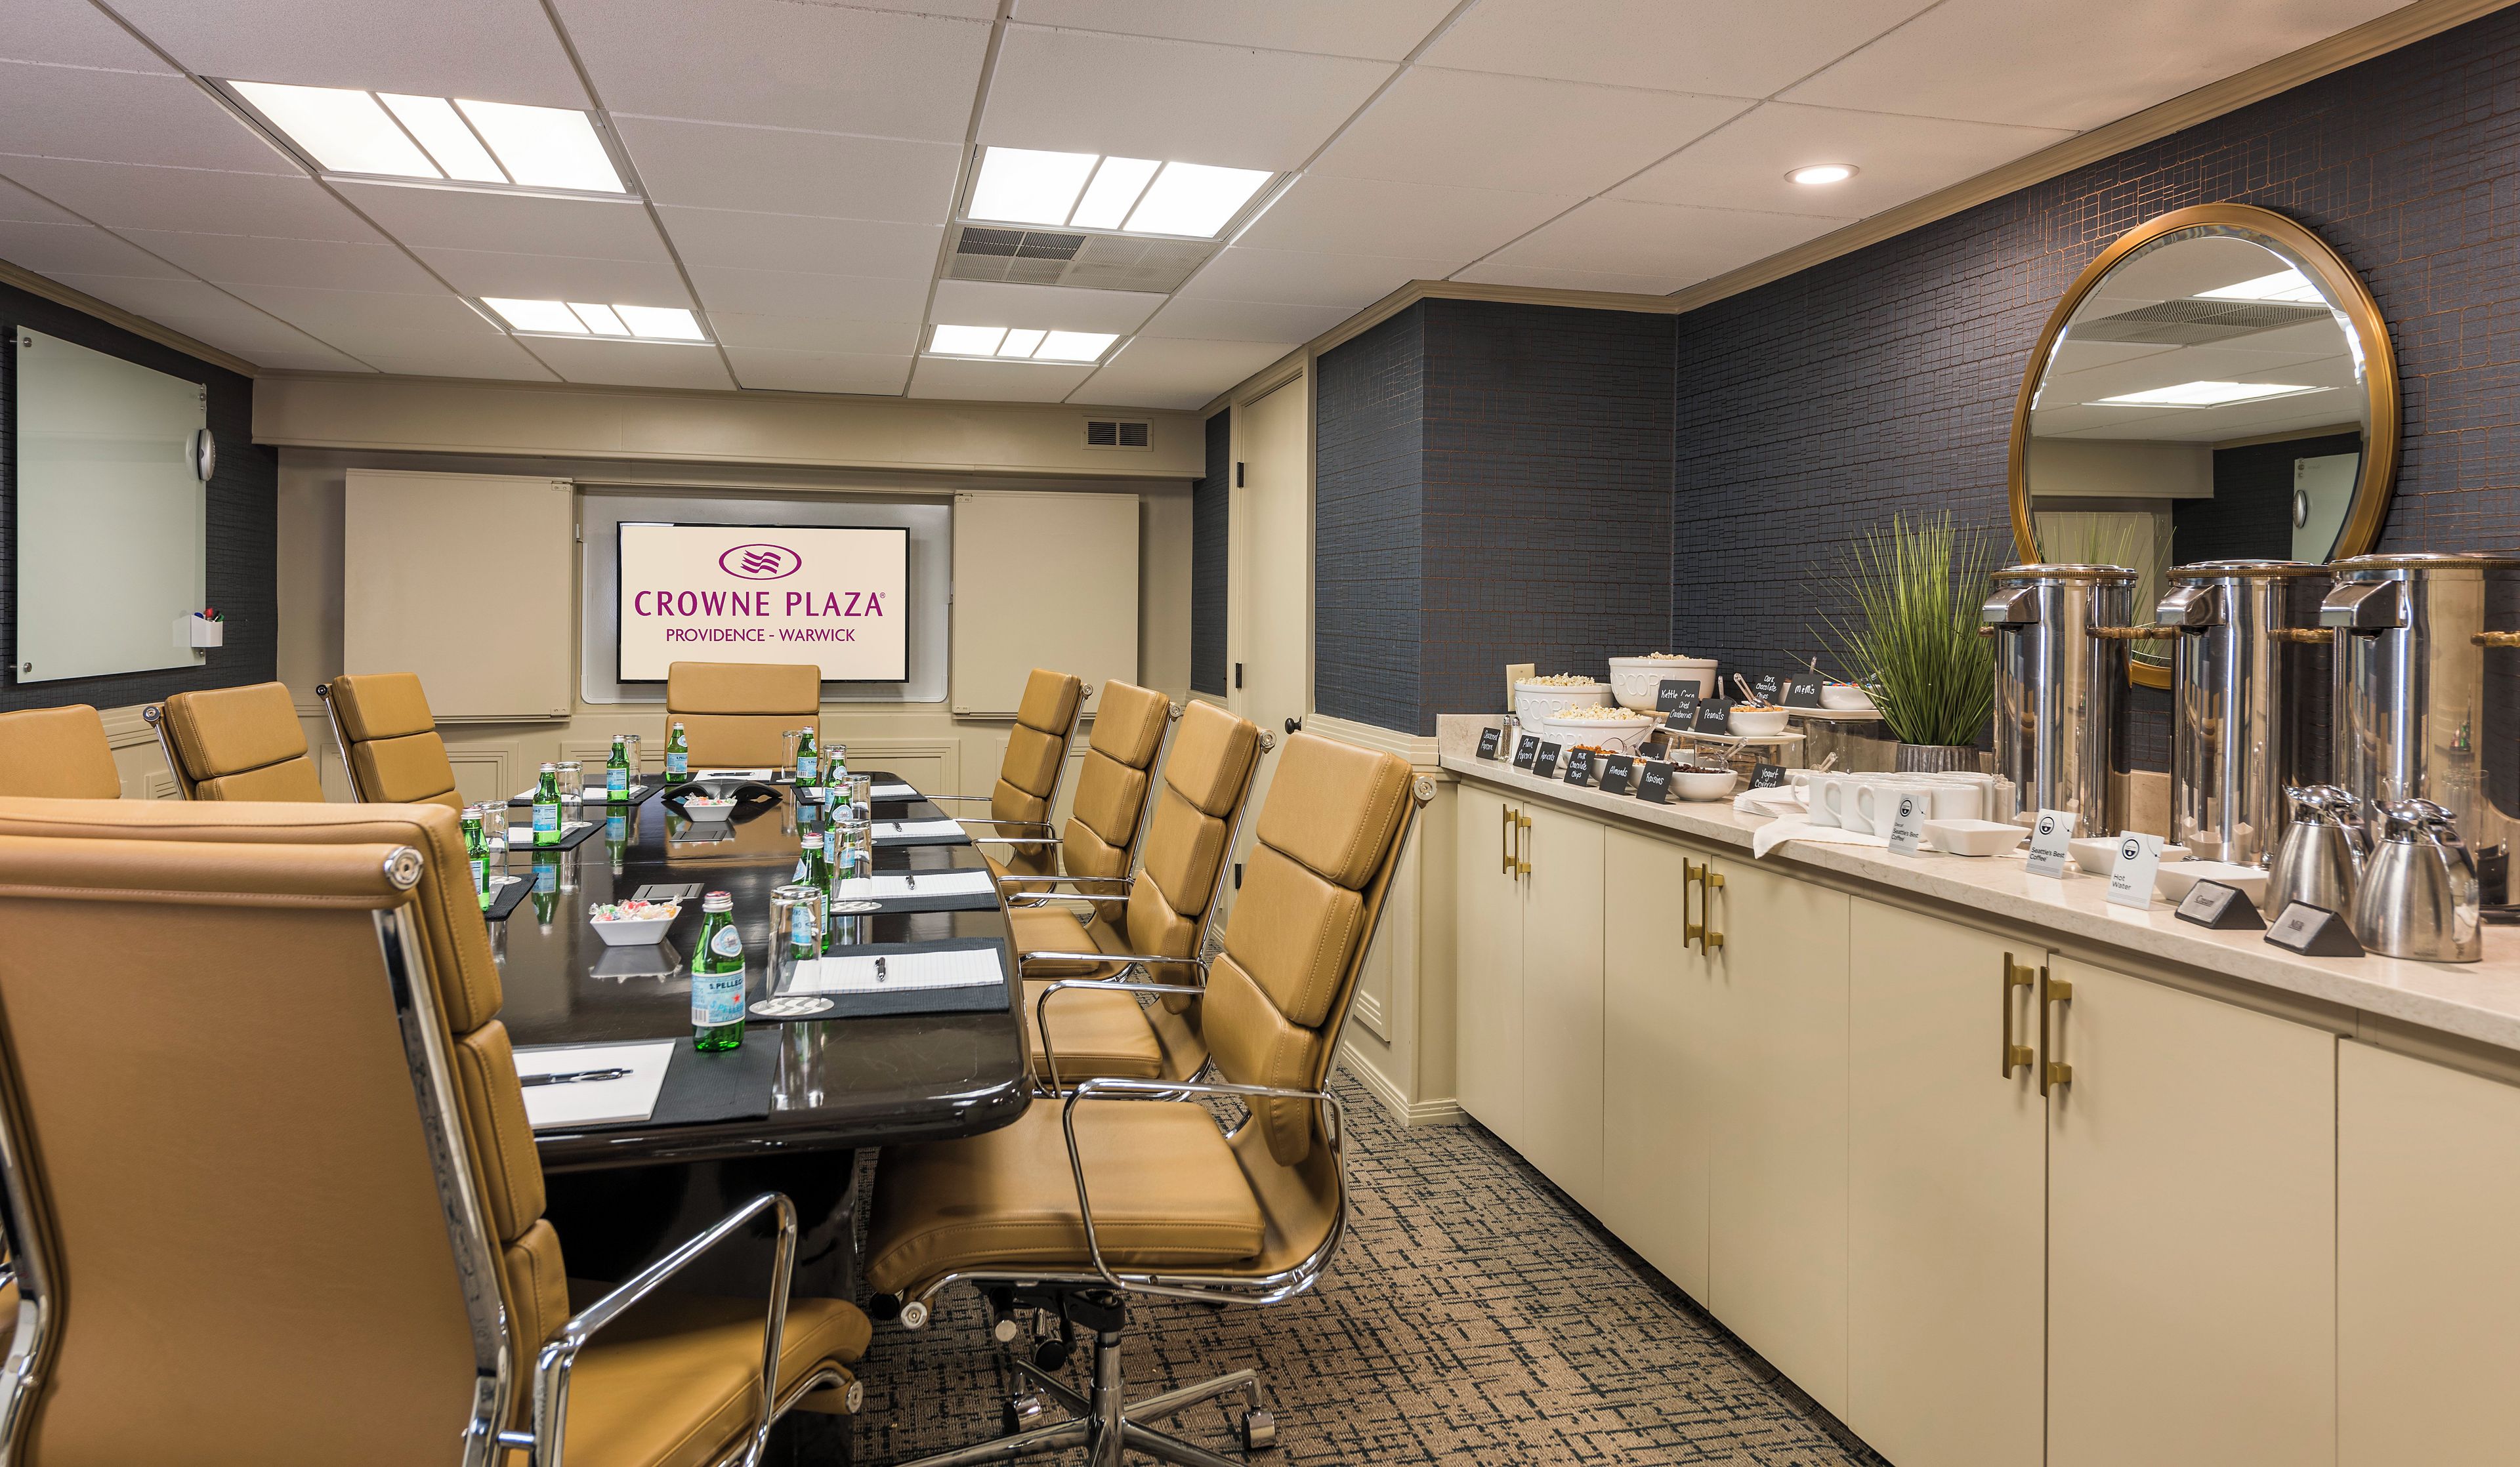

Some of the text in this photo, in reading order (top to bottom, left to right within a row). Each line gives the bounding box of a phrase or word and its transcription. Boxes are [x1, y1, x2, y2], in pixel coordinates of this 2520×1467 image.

[634, 590, 770, 617] CROWNE
[666, 629, 765, 642] PROVIDENCE
[779, 629, 856, 642] WARWICK
[1661, 689, 1678, 699] Kettle
[1704, 709, 1725, 720] Peanuts
[1480, 740, 1494, 751] Popcorn
[1522, 738, 1534, 749] Plain
[1517, 749, 1532, 762] Popcorn
[1540, 751, 1555, 761] Apricots
[1609, 766, 1628, 777] Almonds
[1761, 768, 1779, 782] Yogurt
[1645, 772, 1664, 785] Raisins
[1754, 779, 1777, 788] Covered
[2031, 847, 2053, 856] Seattle's
[2113, 873, 2126, 882] Hot
[2112, 881, 2132, 890] Water
